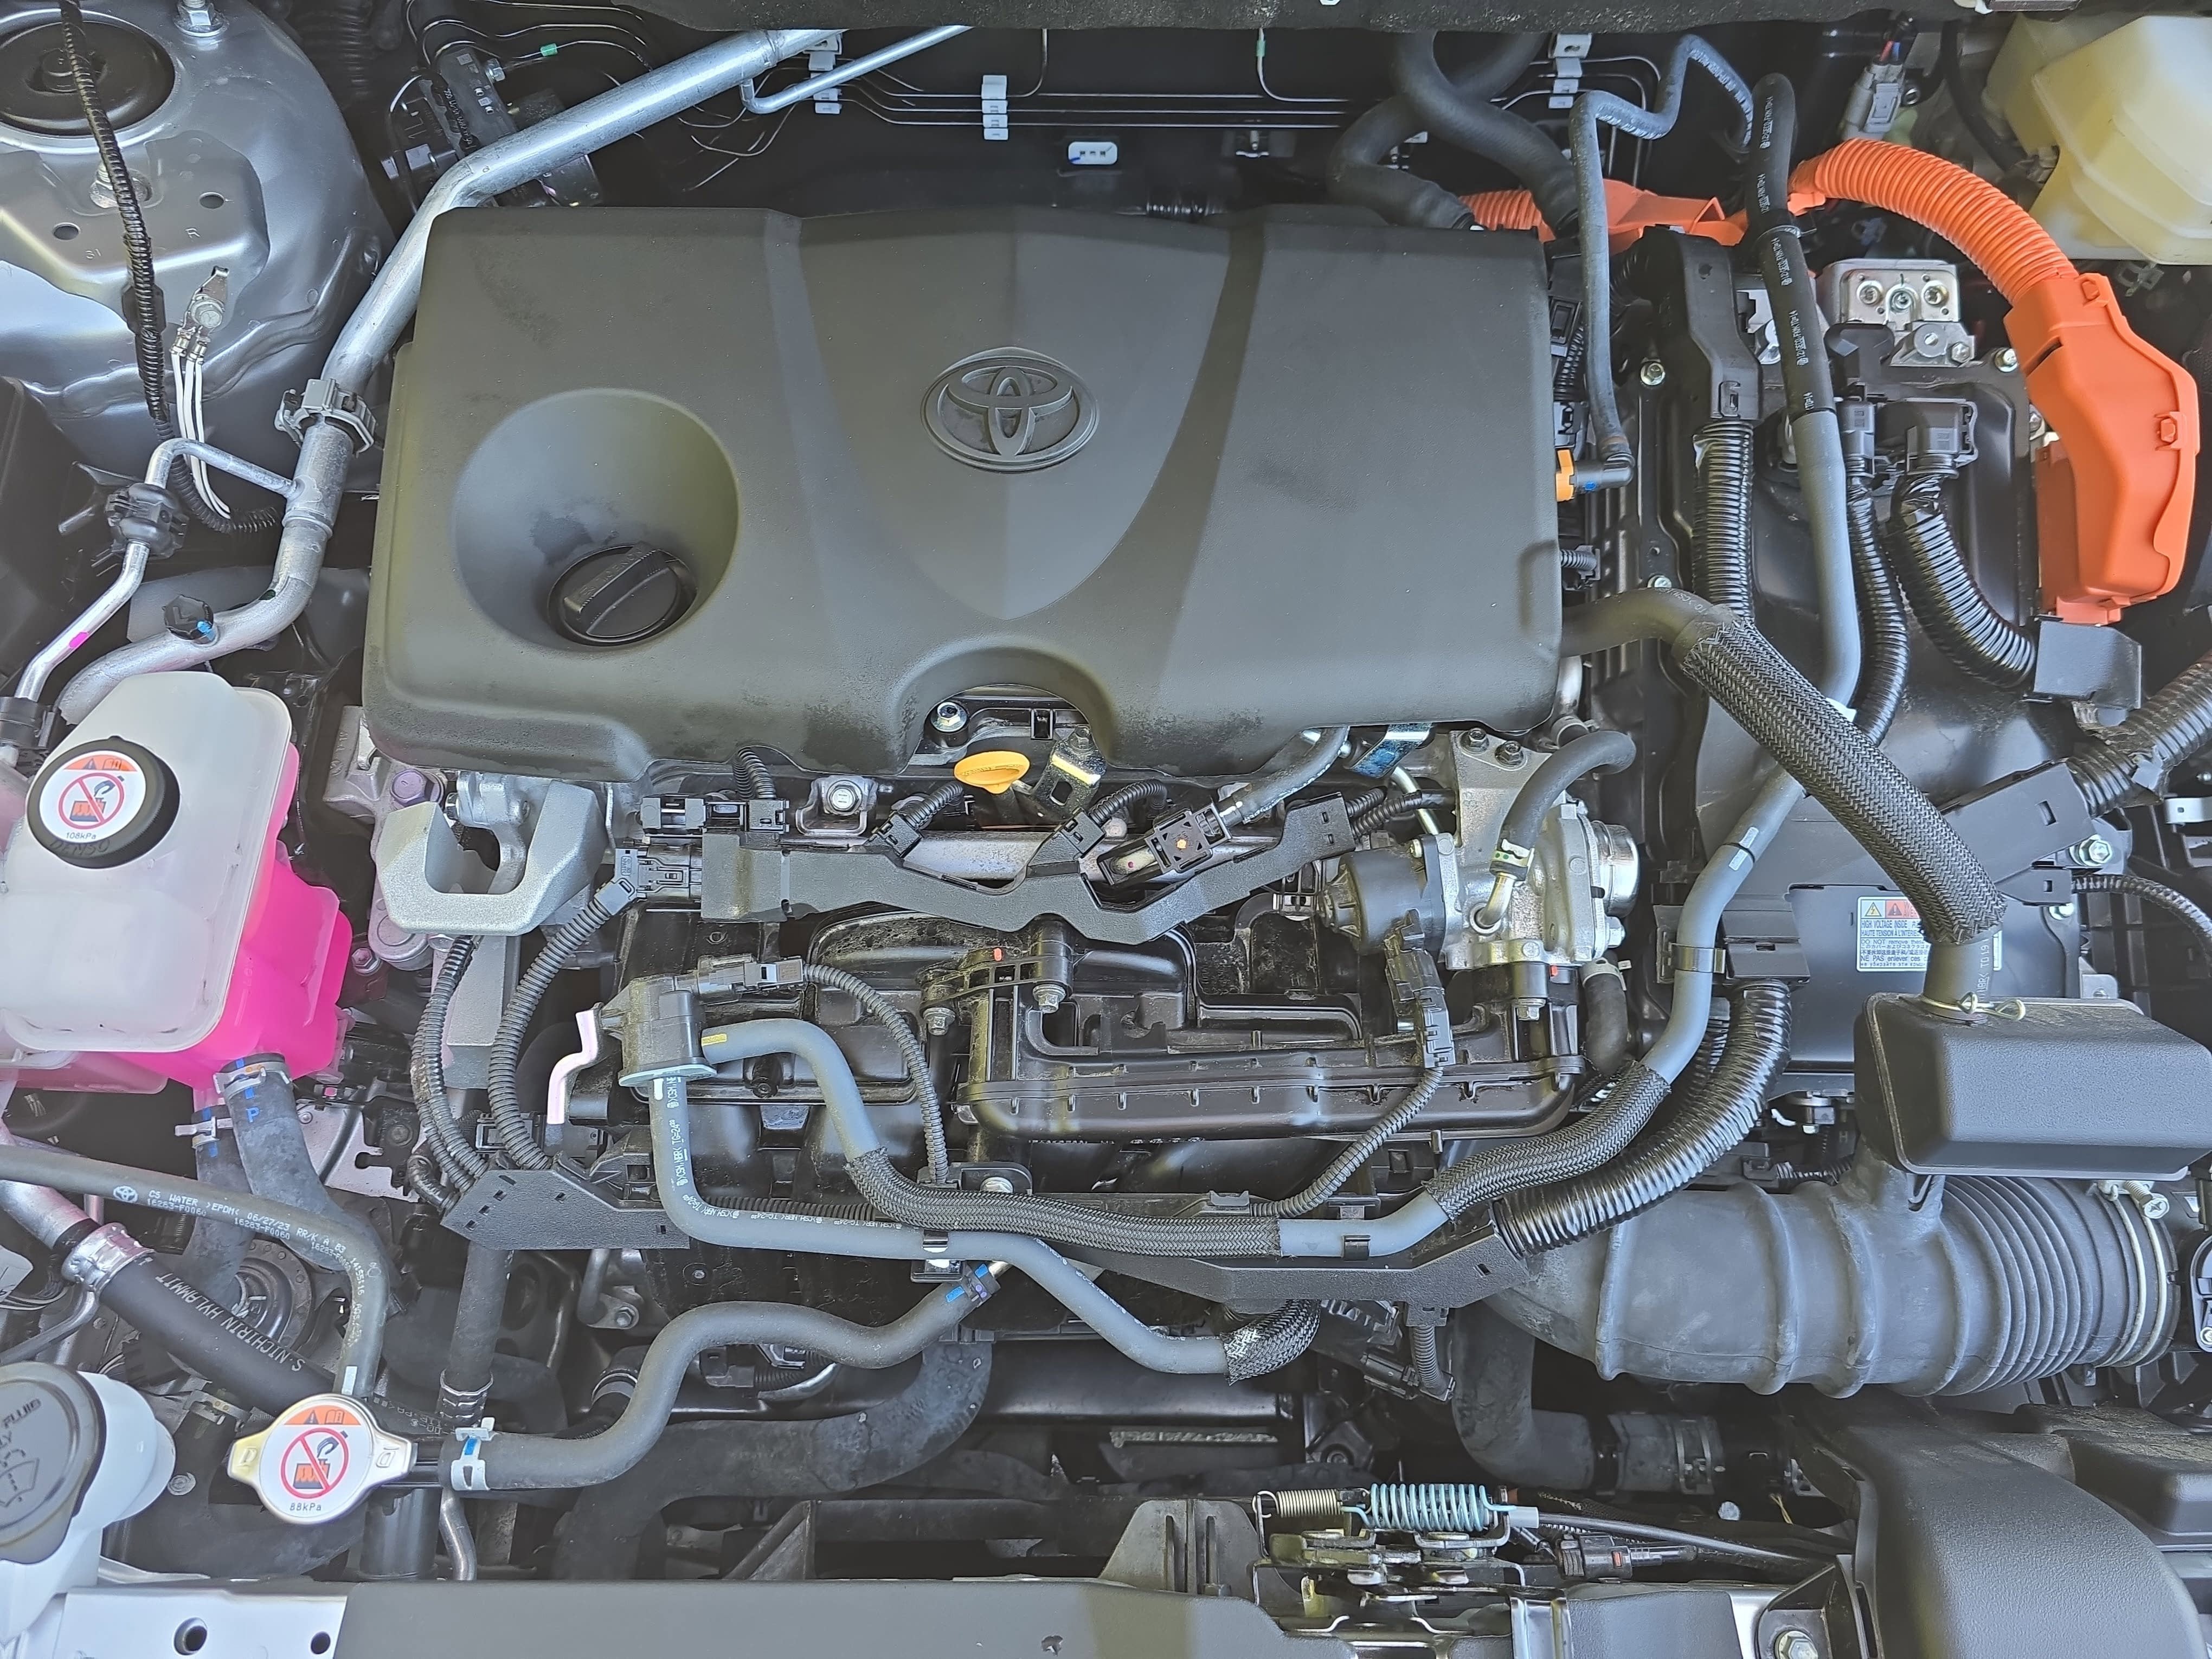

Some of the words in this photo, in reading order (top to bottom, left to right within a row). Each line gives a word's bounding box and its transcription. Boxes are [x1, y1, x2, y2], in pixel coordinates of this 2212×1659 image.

[66, 832, 97, 840] 108kPa
[49, 839, 111, 856] DENSO
[1861, 920, 1872, 928] HIGH
[1873, 920, 1893, 928] VOLTAGE
[1894, 920, 1907, 928] INSIDE
[246, 1107, 259, 1123] P
[169, 1193, 198, 1207] WATER
[247, 1212, 291, 1231] 06/27/23
[234, 1217, 291, 1240] 16283-F0060
[155, 1272, 223, 1319] HYLAMMIT
[3, 1398, 42, 1429] FLUID
[290, 1502, 322, 1512] 88kPa
